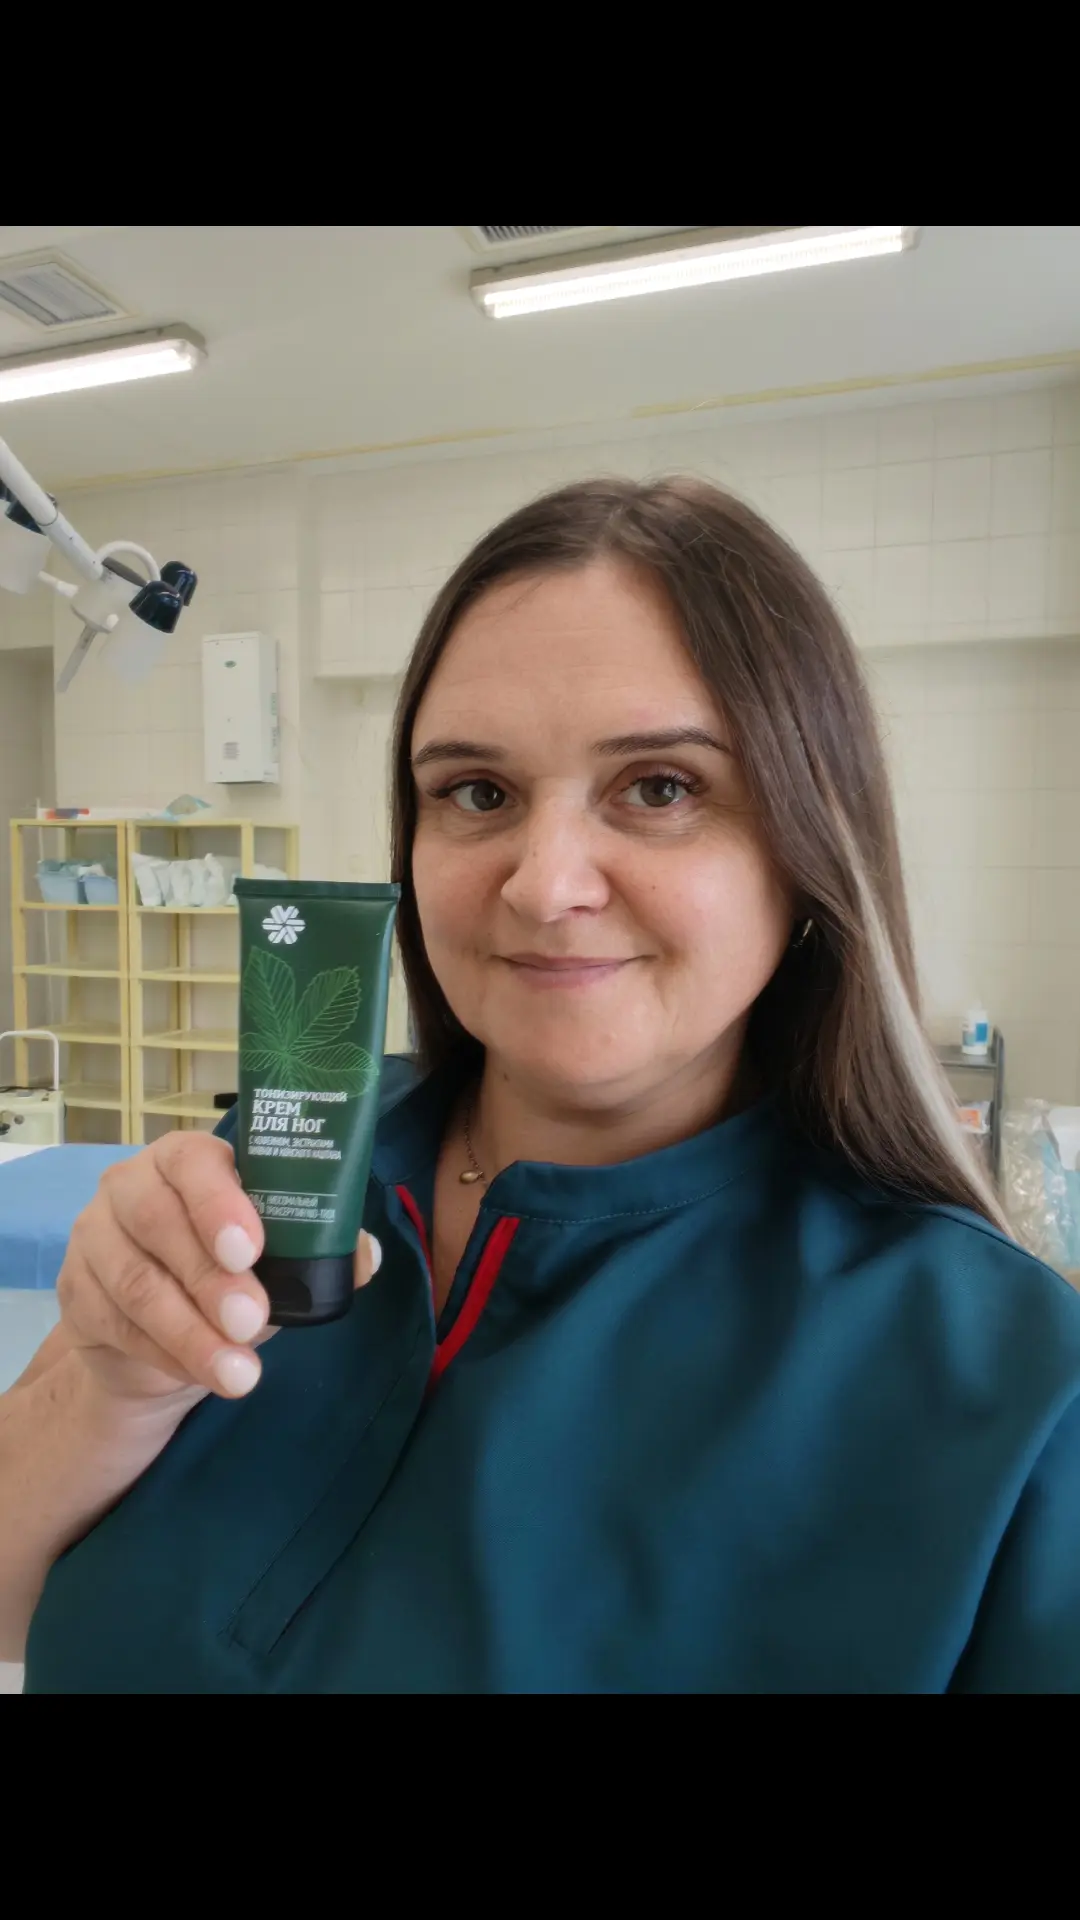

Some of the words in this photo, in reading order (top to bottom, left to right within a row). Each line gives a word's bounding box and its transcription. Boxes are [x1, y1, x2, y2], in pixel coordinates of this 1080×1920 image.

[253, 1088, 348, 1102] ТОНИЗИРУЮЩИЙ
[252, 1099, 302, 1116] КРЕМ
[249, 1115, 290, 1132] ДЛЯ
[291, 1118, 326, 1133] НОГ
